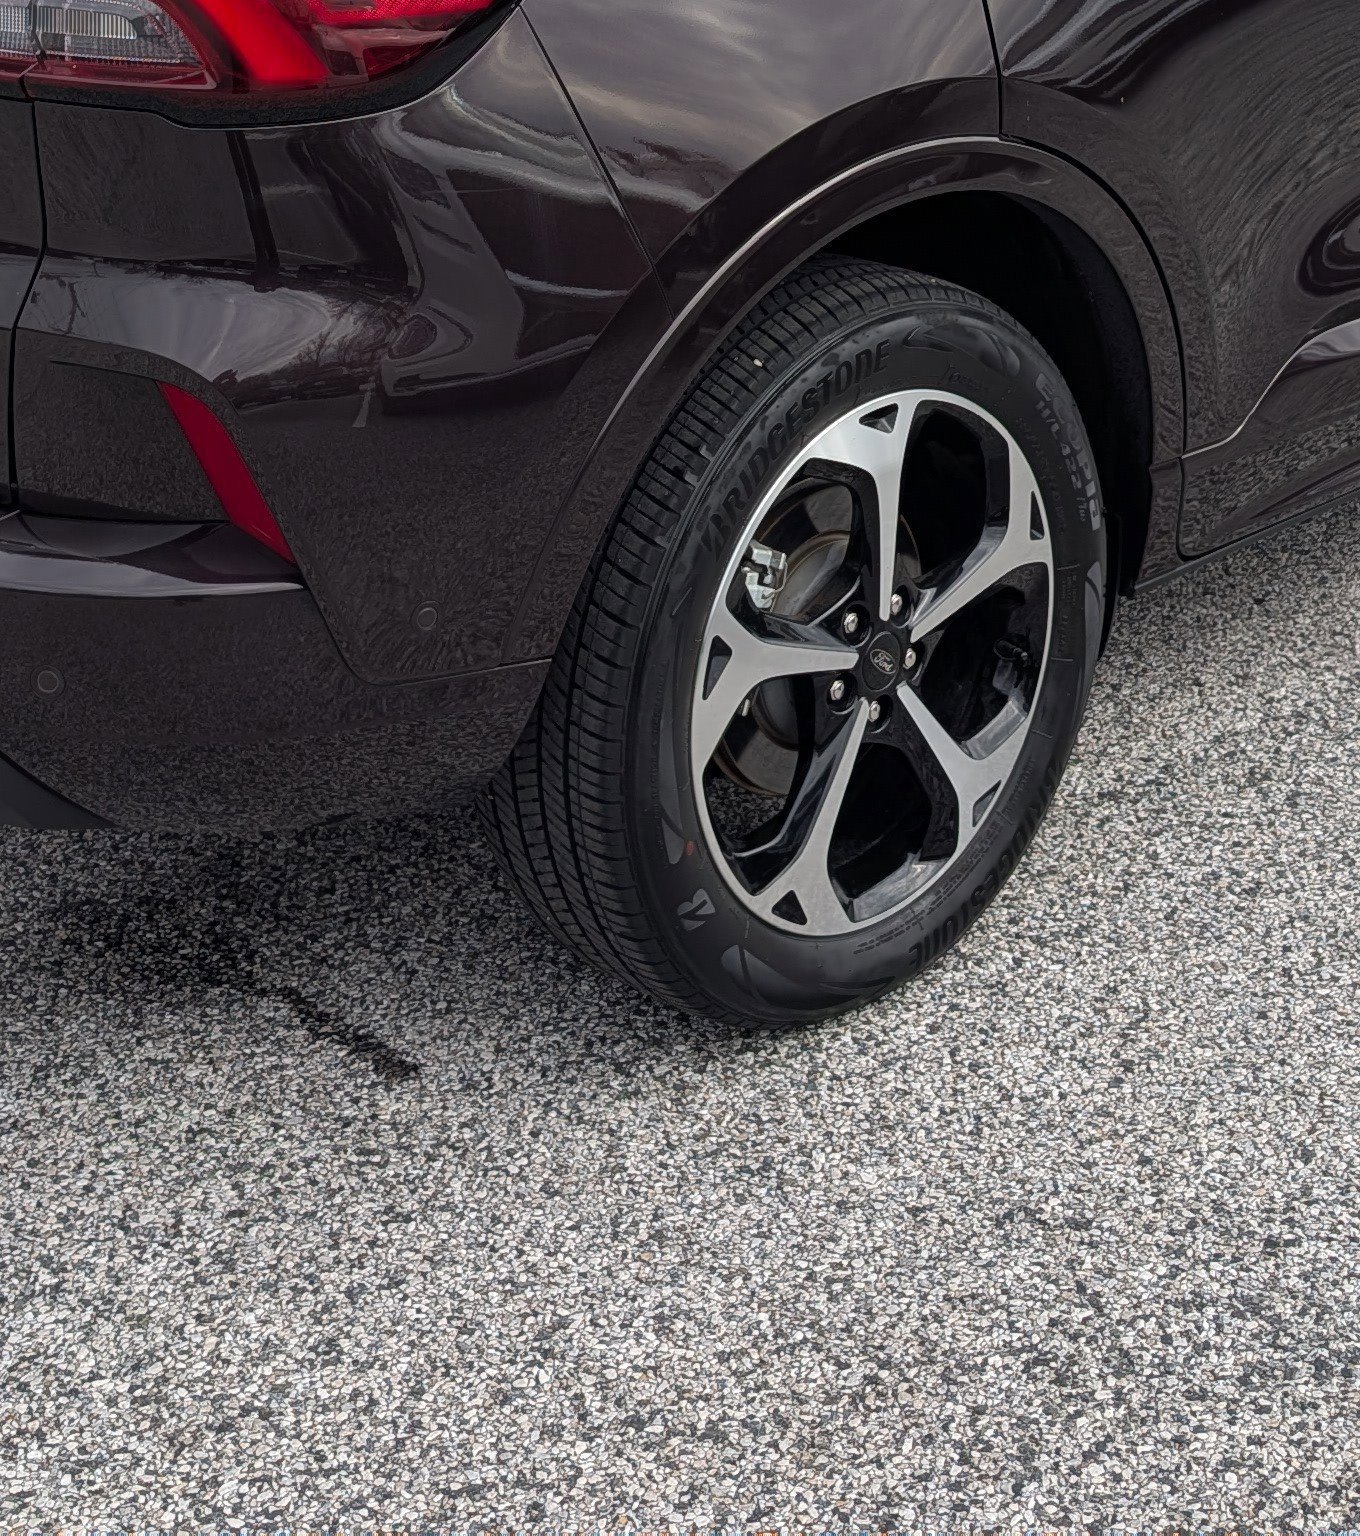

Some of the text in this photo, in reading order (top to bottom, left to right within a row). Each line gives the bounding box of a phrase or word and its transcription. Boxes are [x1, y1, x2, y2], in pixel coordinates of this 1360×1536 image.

[700, 338, 891, 560] BRIDGESTONE
[1035, 372, 1102, 531] ECOPIA
[873, 652, 894, 672] Ford
